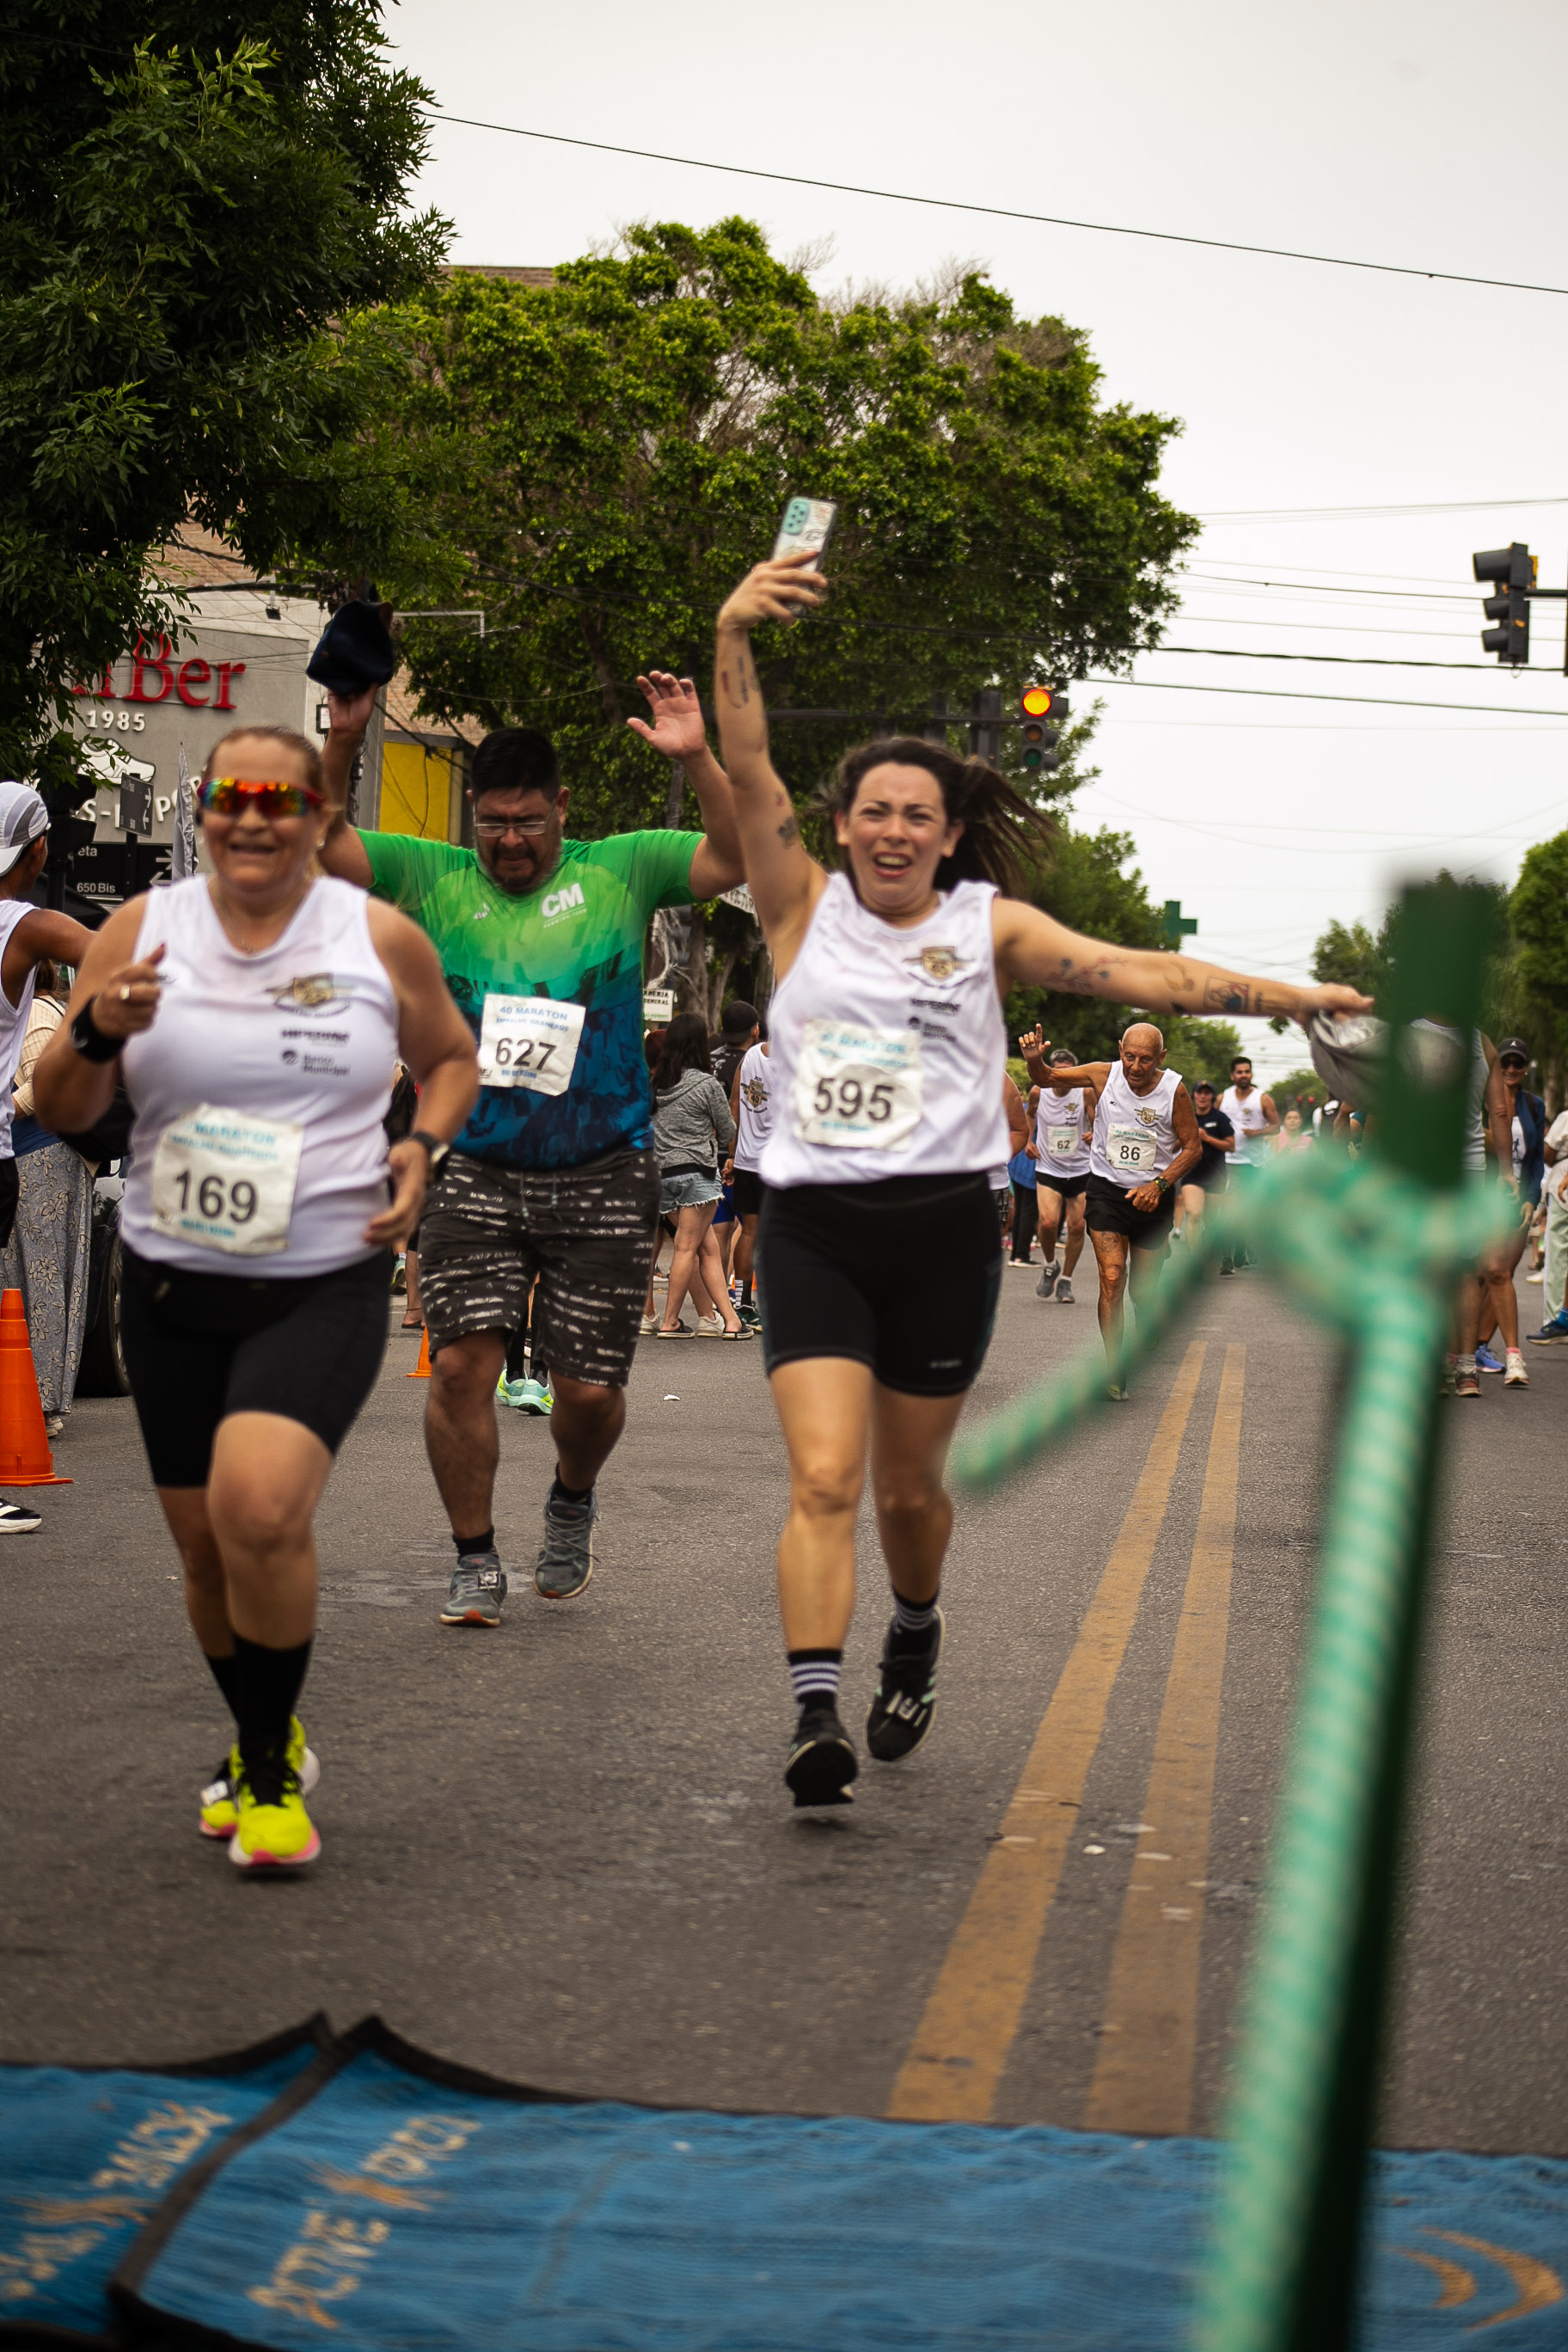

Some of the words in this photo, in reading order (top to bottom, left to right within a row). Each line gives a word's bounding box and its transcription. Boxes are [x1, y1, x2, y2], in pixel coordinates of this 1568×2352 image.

[86, 710, 145, 732] 1985
[77, 883, 96, 893] 650
[98, 883, 116, 893] Bis
[542, 883, 585, 917] CM
[515, 1008, 568, 1021] MARATON
[495, 1038, 557, 1071] 627
[750, 1094, 760, 1104] 40
[814, 1077, 895, 1122] 595
[1057, 1140, 1071, 1150] 62
[1119, 1145, 1141, 1161] 86
[175, 1170, 259, 1226] 169
